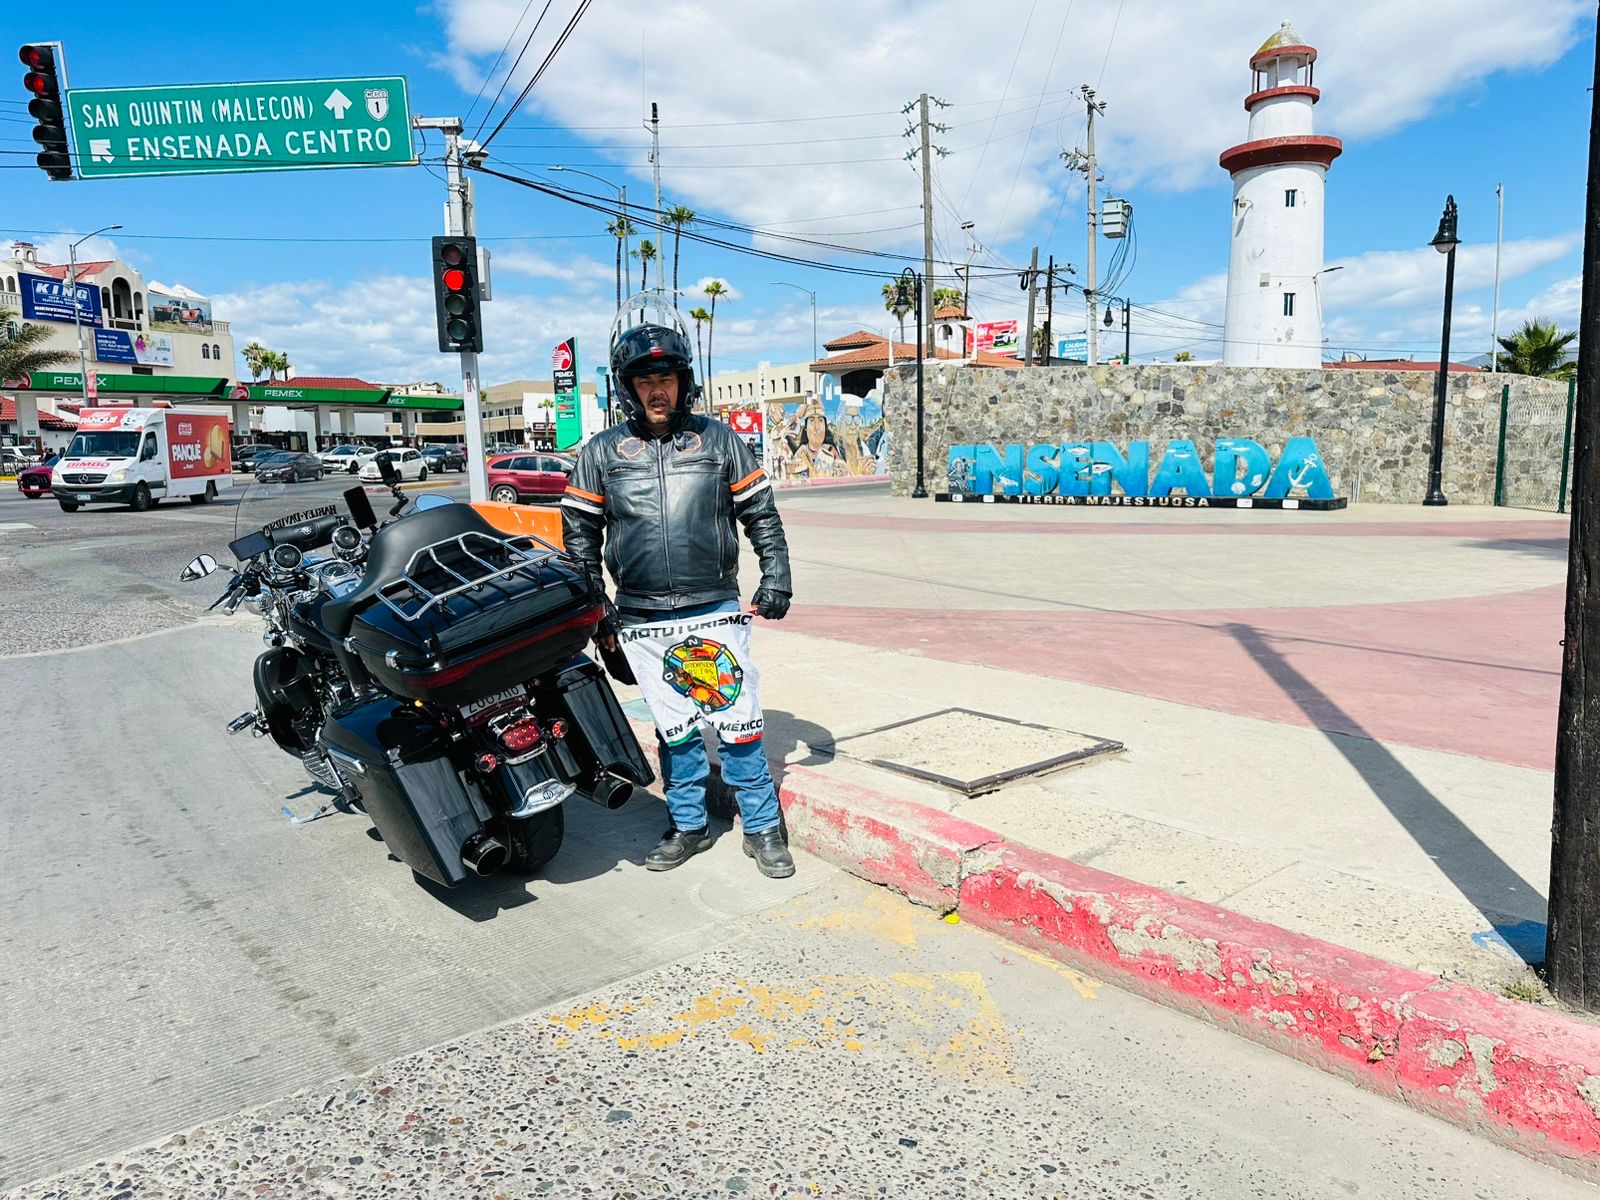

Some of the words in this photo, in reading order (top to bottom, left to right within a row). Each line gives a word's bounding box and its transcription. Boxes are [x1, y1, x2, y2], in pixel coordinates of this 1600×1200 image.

[83, 103, 120, 129] SAN
[128, 100, 204, 127] QUINTIN
[211, 95, 314, 122] (MALECON)
[374, 101, 380, 113] 1
[128, 133, 273, 161] ENSENADA
[285, 127, 392, 155] CENTRO
[36, 282, 88, 300] KING
[53, 376, 107, 387] PEMX
[264, 389, 303, 398] PEMEX
[171, 439, 202, 462] PANQUÉ
[948, 437, 1336, 499] ENSENADA
[1016, 494, 1077, 505] TIERRA
[1087, 495, 1210, 507] MAJESTUOSA
[665, 724, 683, 737] EN
[719, 718, 763, 733] MÉXICO
